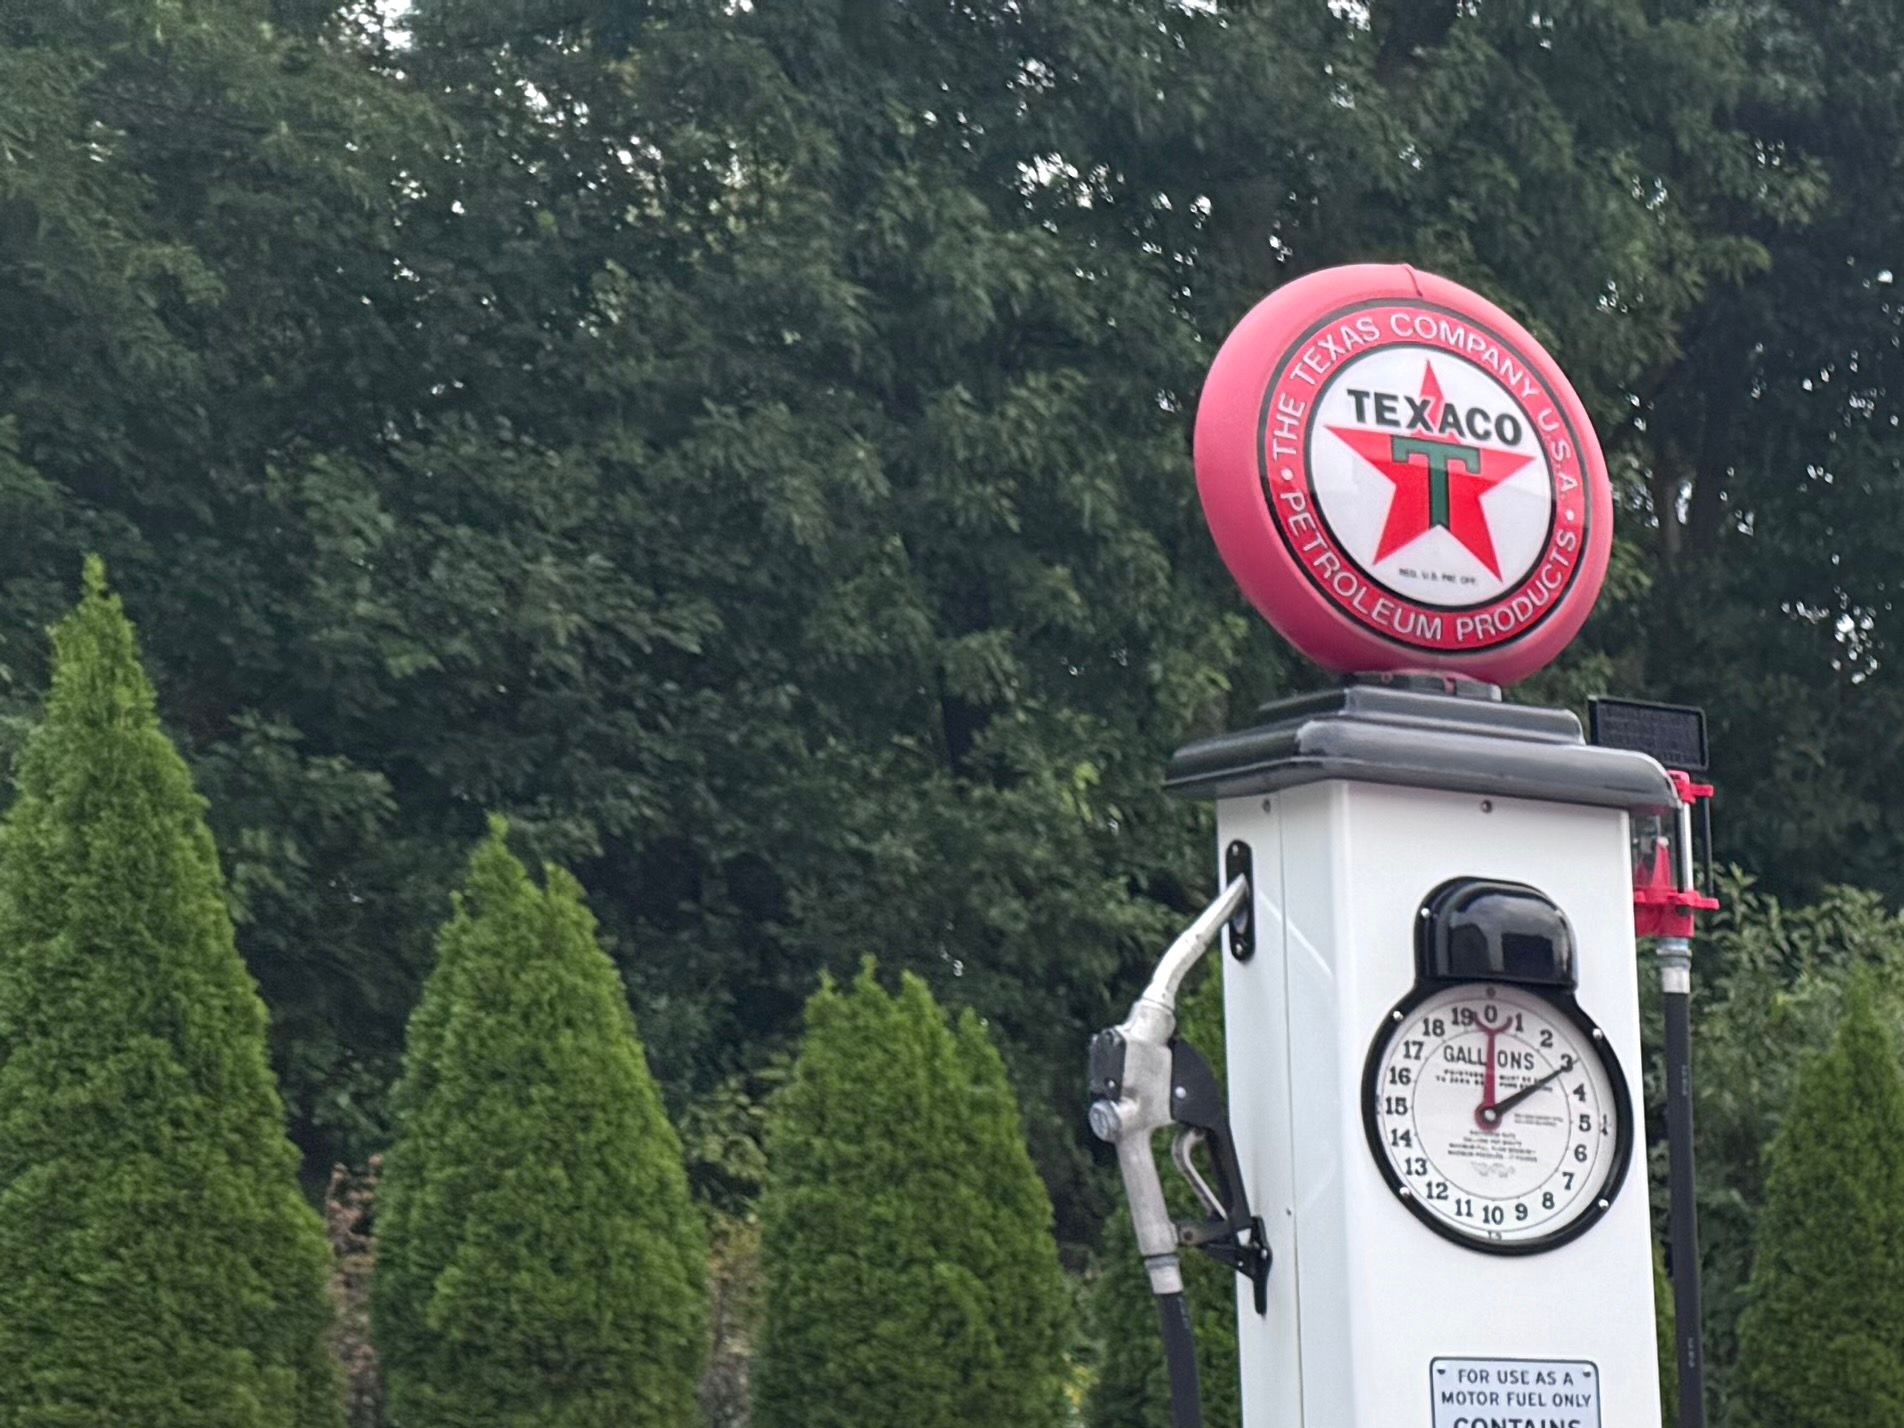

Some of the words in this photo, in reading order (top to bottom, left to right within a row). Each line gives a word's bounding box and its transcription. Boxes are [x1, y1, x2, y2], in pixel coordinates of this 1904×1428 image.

[1273, 394, 1305, 462] THE
[1291, 314, 1380, 386] TEXAS
[1390, 312, 1539, 398] COMPANY
[1347, 388, 1522, 447] TEXACO
[1280, 491, 1443, 641] PETROLEUM
[1456, 528, 1577, 642] PRODUCTS
[1451, 1006, 1475, 1027] 19
[1483, 1004, 1498, 1024] 0
[1515, 1012, 1524, 1033] 1
[1422, 1017, 1446, 1038] 18
[1540, 1028, 1554, 1049] 2
[1403, 1040, 1425, 1061] 17
[1443, 1044, 1535, 1071] GALLONS
[1560, 1053, 1574, 1073] 3
[1389, 1065, 1412, 1086] 16
[1573, 1083, 1587, 1103] 4
[1385, 1096, 1408, 1116] 15
[1578, 1113, 1592, 1133] 5
[1391, 1128, 1413, 1148] 14
[1574, 1143, 1588, 1163] 6
[1405, 1156, 1428, 1177] 13
[1426, 1180, 1449, 1201] 12
[1562, 1171, 1575, 1191] 7
[1455, 1198, 1474, 1218] 11
[1541, 1190, 1555, 1210] 8
[1482, 1204, 1505, 1225] 10
[1514, 1202, 1529, 1221] 9
[1458, 1368, 1490, 1385] FOR
[1497, 1369, 1530, 1386] USE
[1535, 1371, 1557, 1386] AS
[1562, 1372, 1574, 1387] A
[1441, 1391, 1500, 1407] MOTOR
[1507, 1392, 1547, 1408] FUEL
[1552, 1393, 1592, 1408] ONLY
